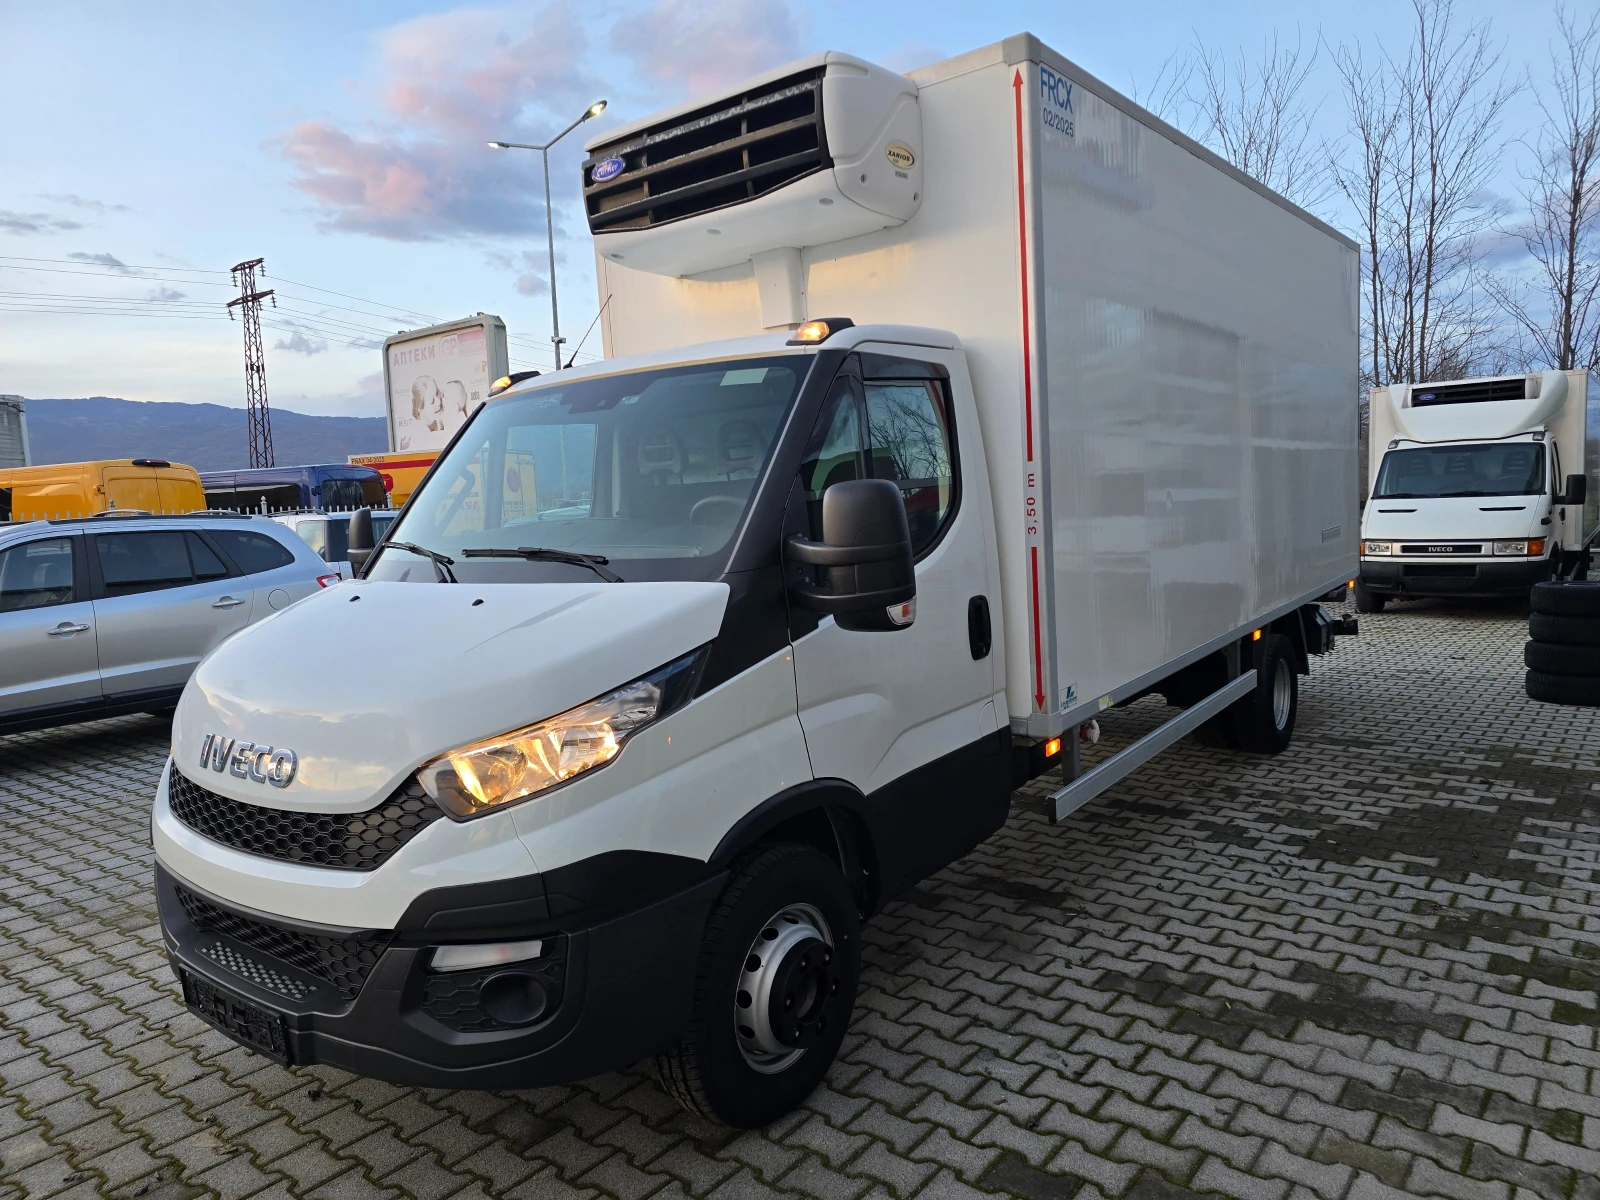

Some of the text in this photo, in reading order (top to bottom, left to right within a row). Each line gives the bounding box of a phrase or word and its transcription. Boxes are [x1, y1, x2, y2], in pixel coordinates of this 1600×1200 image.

[1040, 65, 1074, 114] FRCX
[1043, 107, 1074, 138] 02/2025
[888, 150, 910, 161] XARIOS
[393, 344, 436, 367] АПТЕКИ
[1027, 472, 1038, 535] 3,50 m
[199, 733, 298, 788] IVECO
